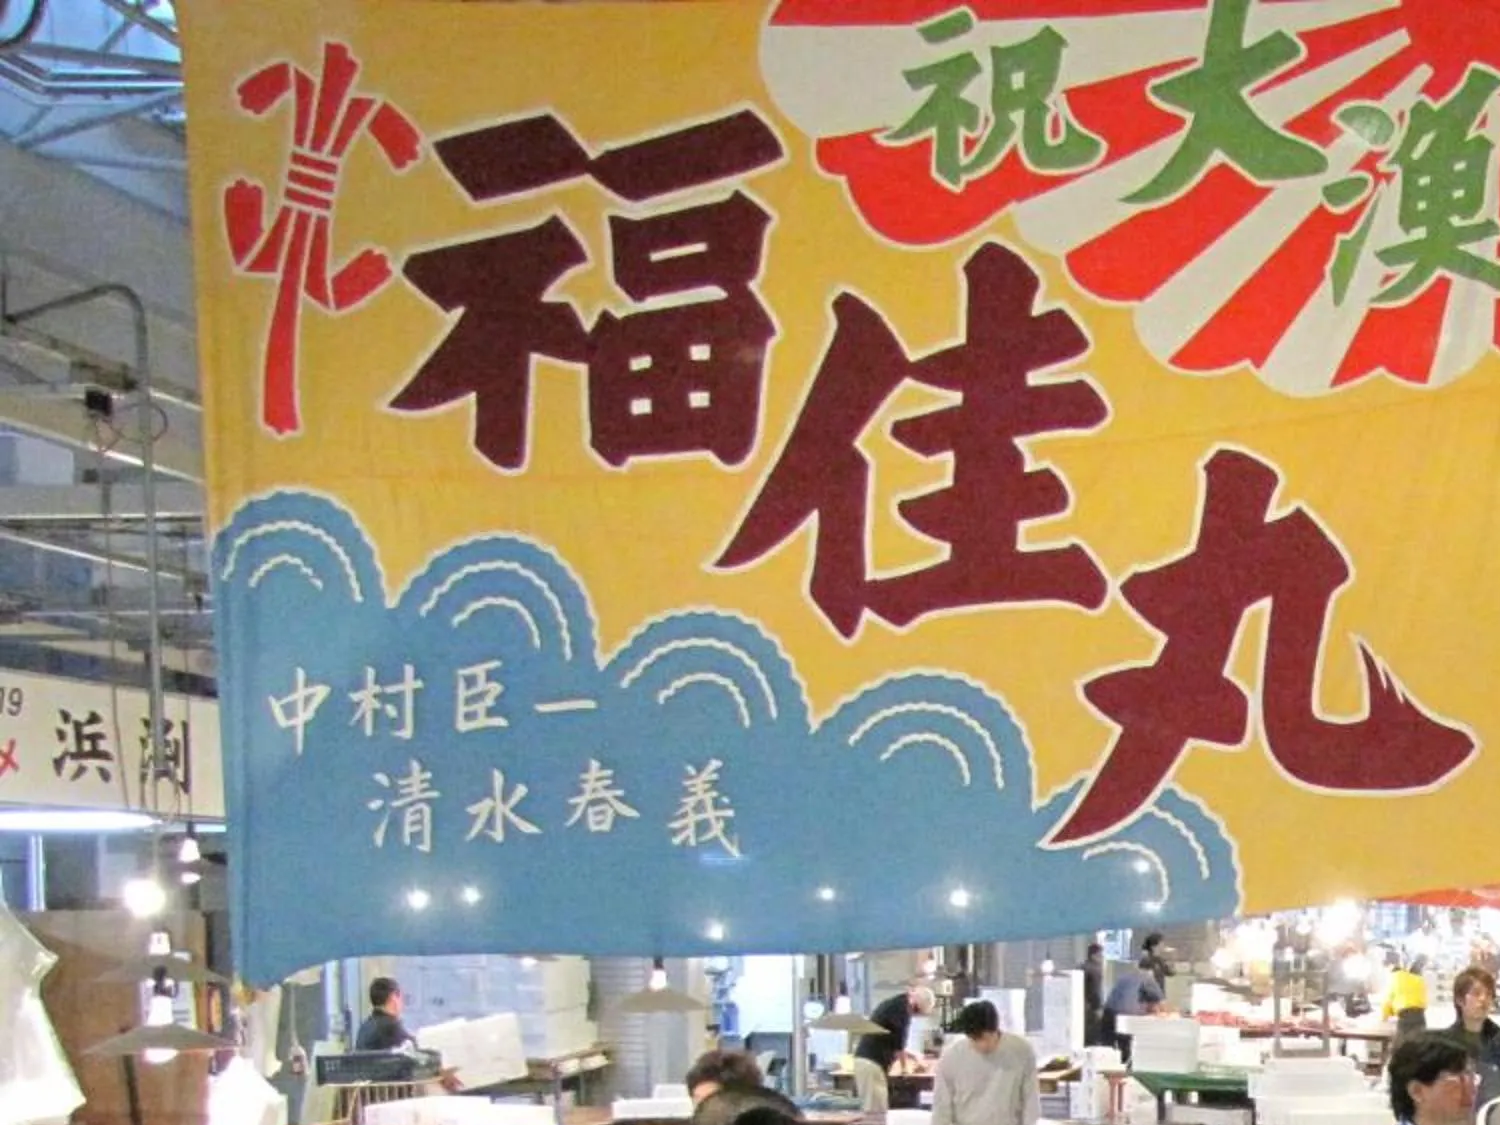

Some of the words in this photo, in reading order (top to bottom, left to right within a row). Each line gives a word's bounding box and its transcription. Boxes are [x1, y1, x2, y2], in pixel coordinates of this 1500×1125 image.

[388, 110, 1477, 846] 福佳丸
[269, 659, 599, 756] 中村臣一
[368, 758, 741, 858] 清水春義
